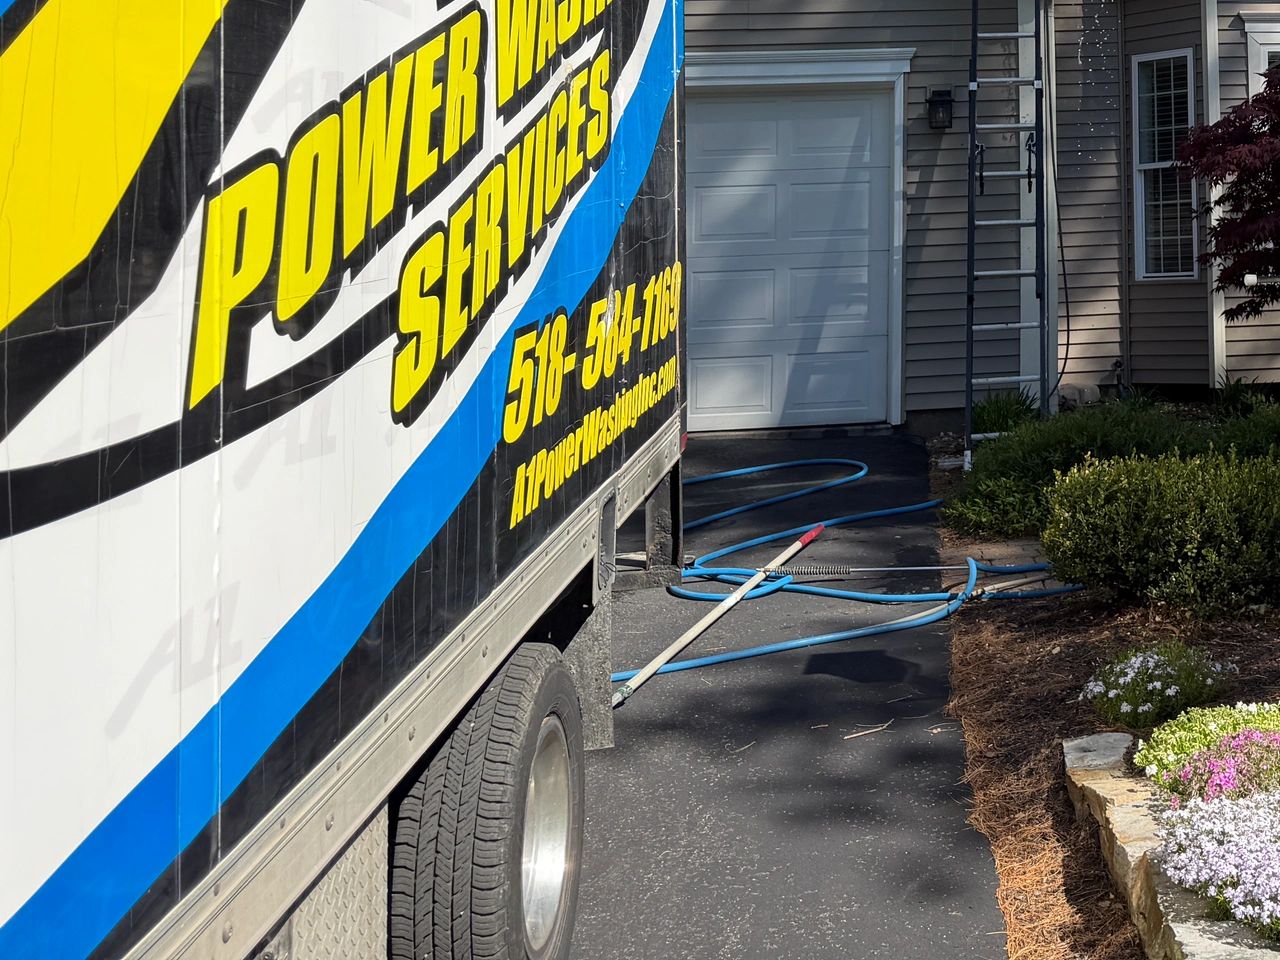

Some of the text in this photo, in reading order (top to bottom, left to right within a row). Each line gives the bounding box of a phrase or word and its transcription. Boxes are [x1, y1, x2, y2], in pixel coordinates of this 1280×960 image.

[189, 10, 482, 410] POWER
[392, 49, 611, 413] SERVICES
[509, 355, 676, 530] A1PowerWashingInc.com
